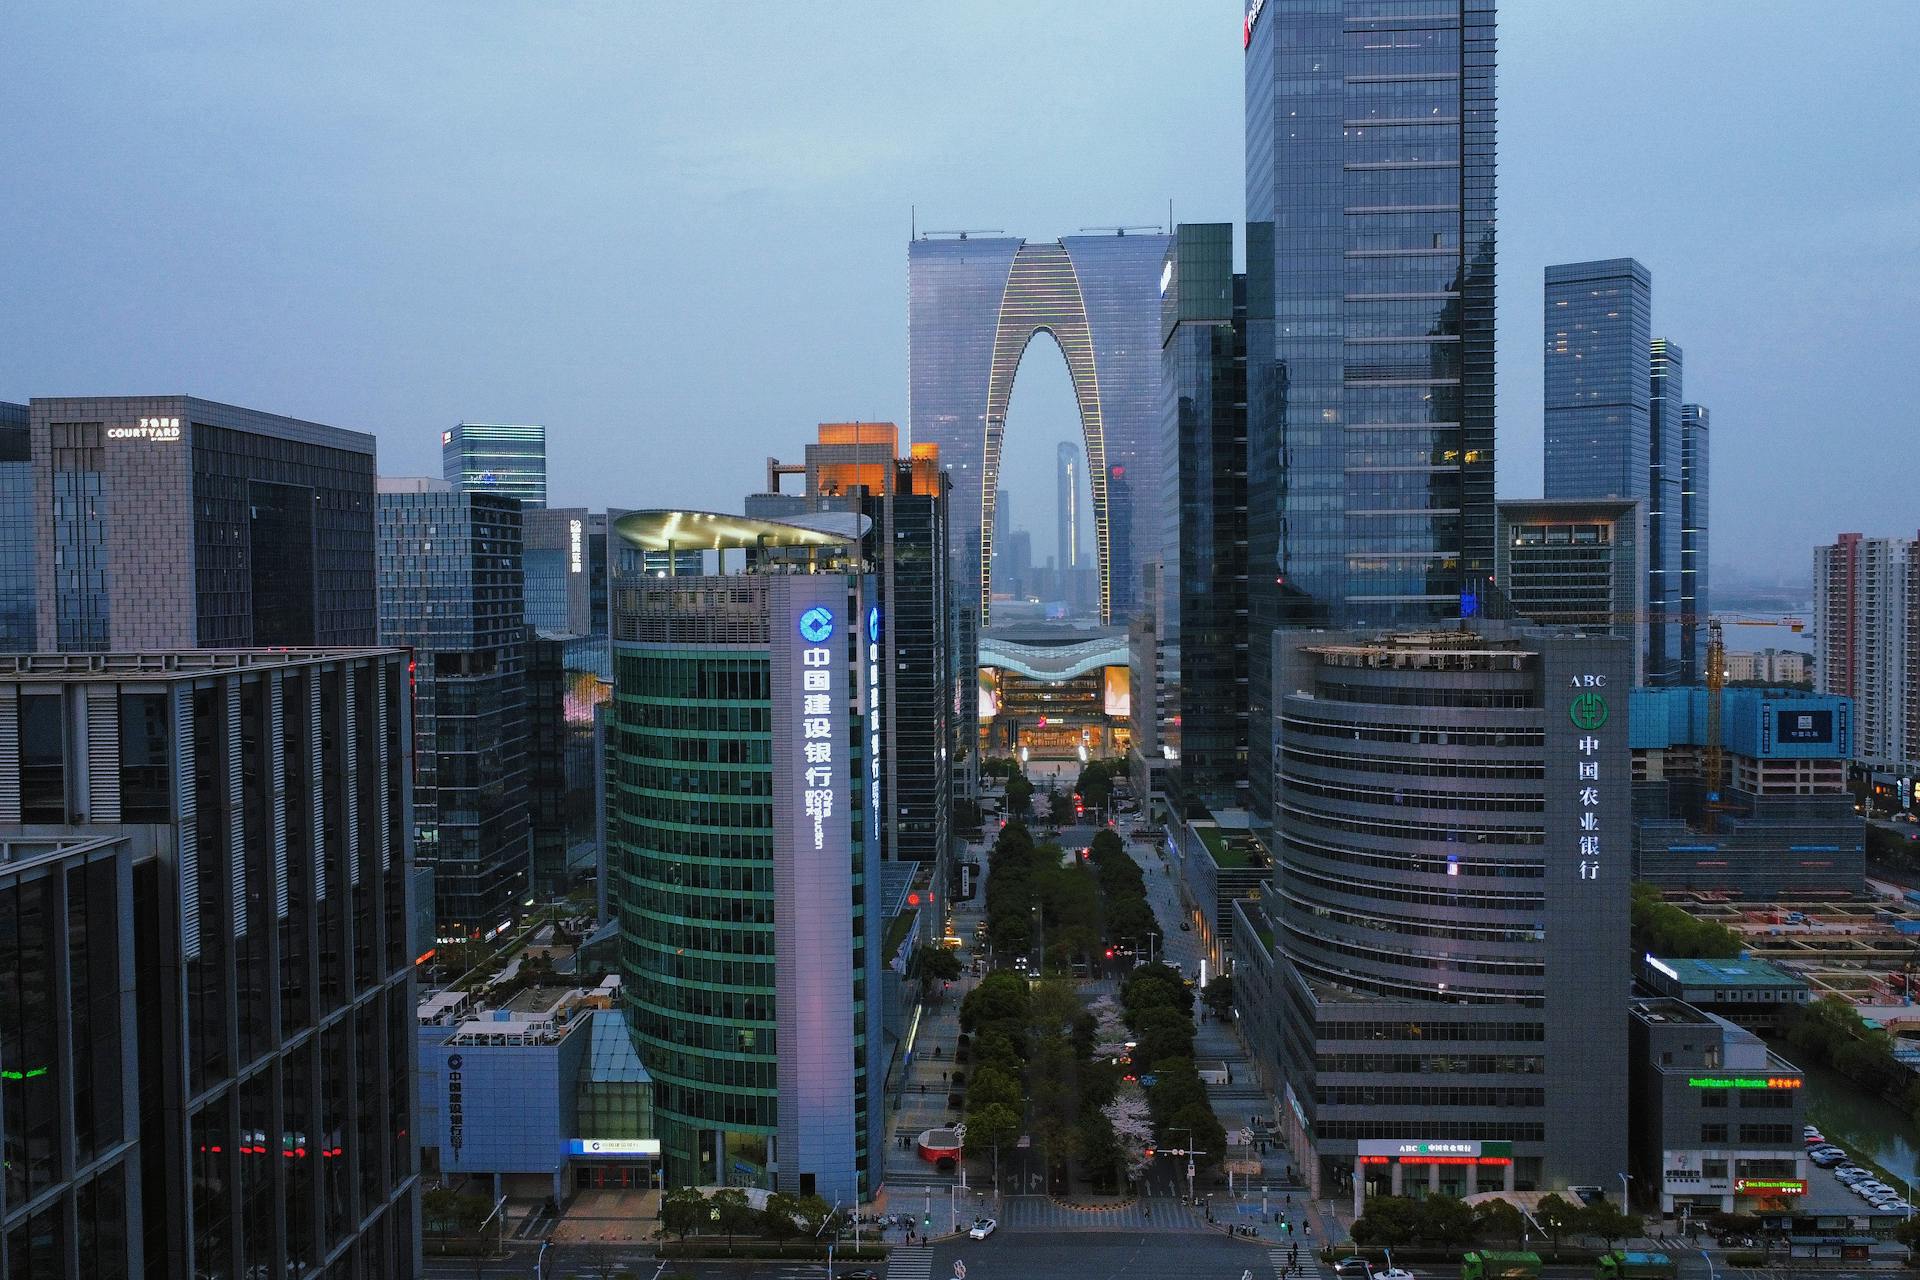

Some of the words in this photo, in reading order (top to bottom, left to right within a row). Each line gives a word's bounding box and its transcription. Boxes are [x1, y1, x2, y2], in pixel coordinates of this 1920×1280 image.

[107, 428, 180, 438] COURTYARD
[1569, 675, 1607, 687] ABC
[803, 648, 833, 787] 中国建设银行
[805, 790, 815, 817] Bank
[823, 789, 833, 818] China
[1579, 736, 1600, 880] 中国农业银行
[814, 789, 824, 849] Construction
[449, 1072, 463, 1135] 中国建设银行
[1428, 1144, 1472, 1152] 中国农业银行
